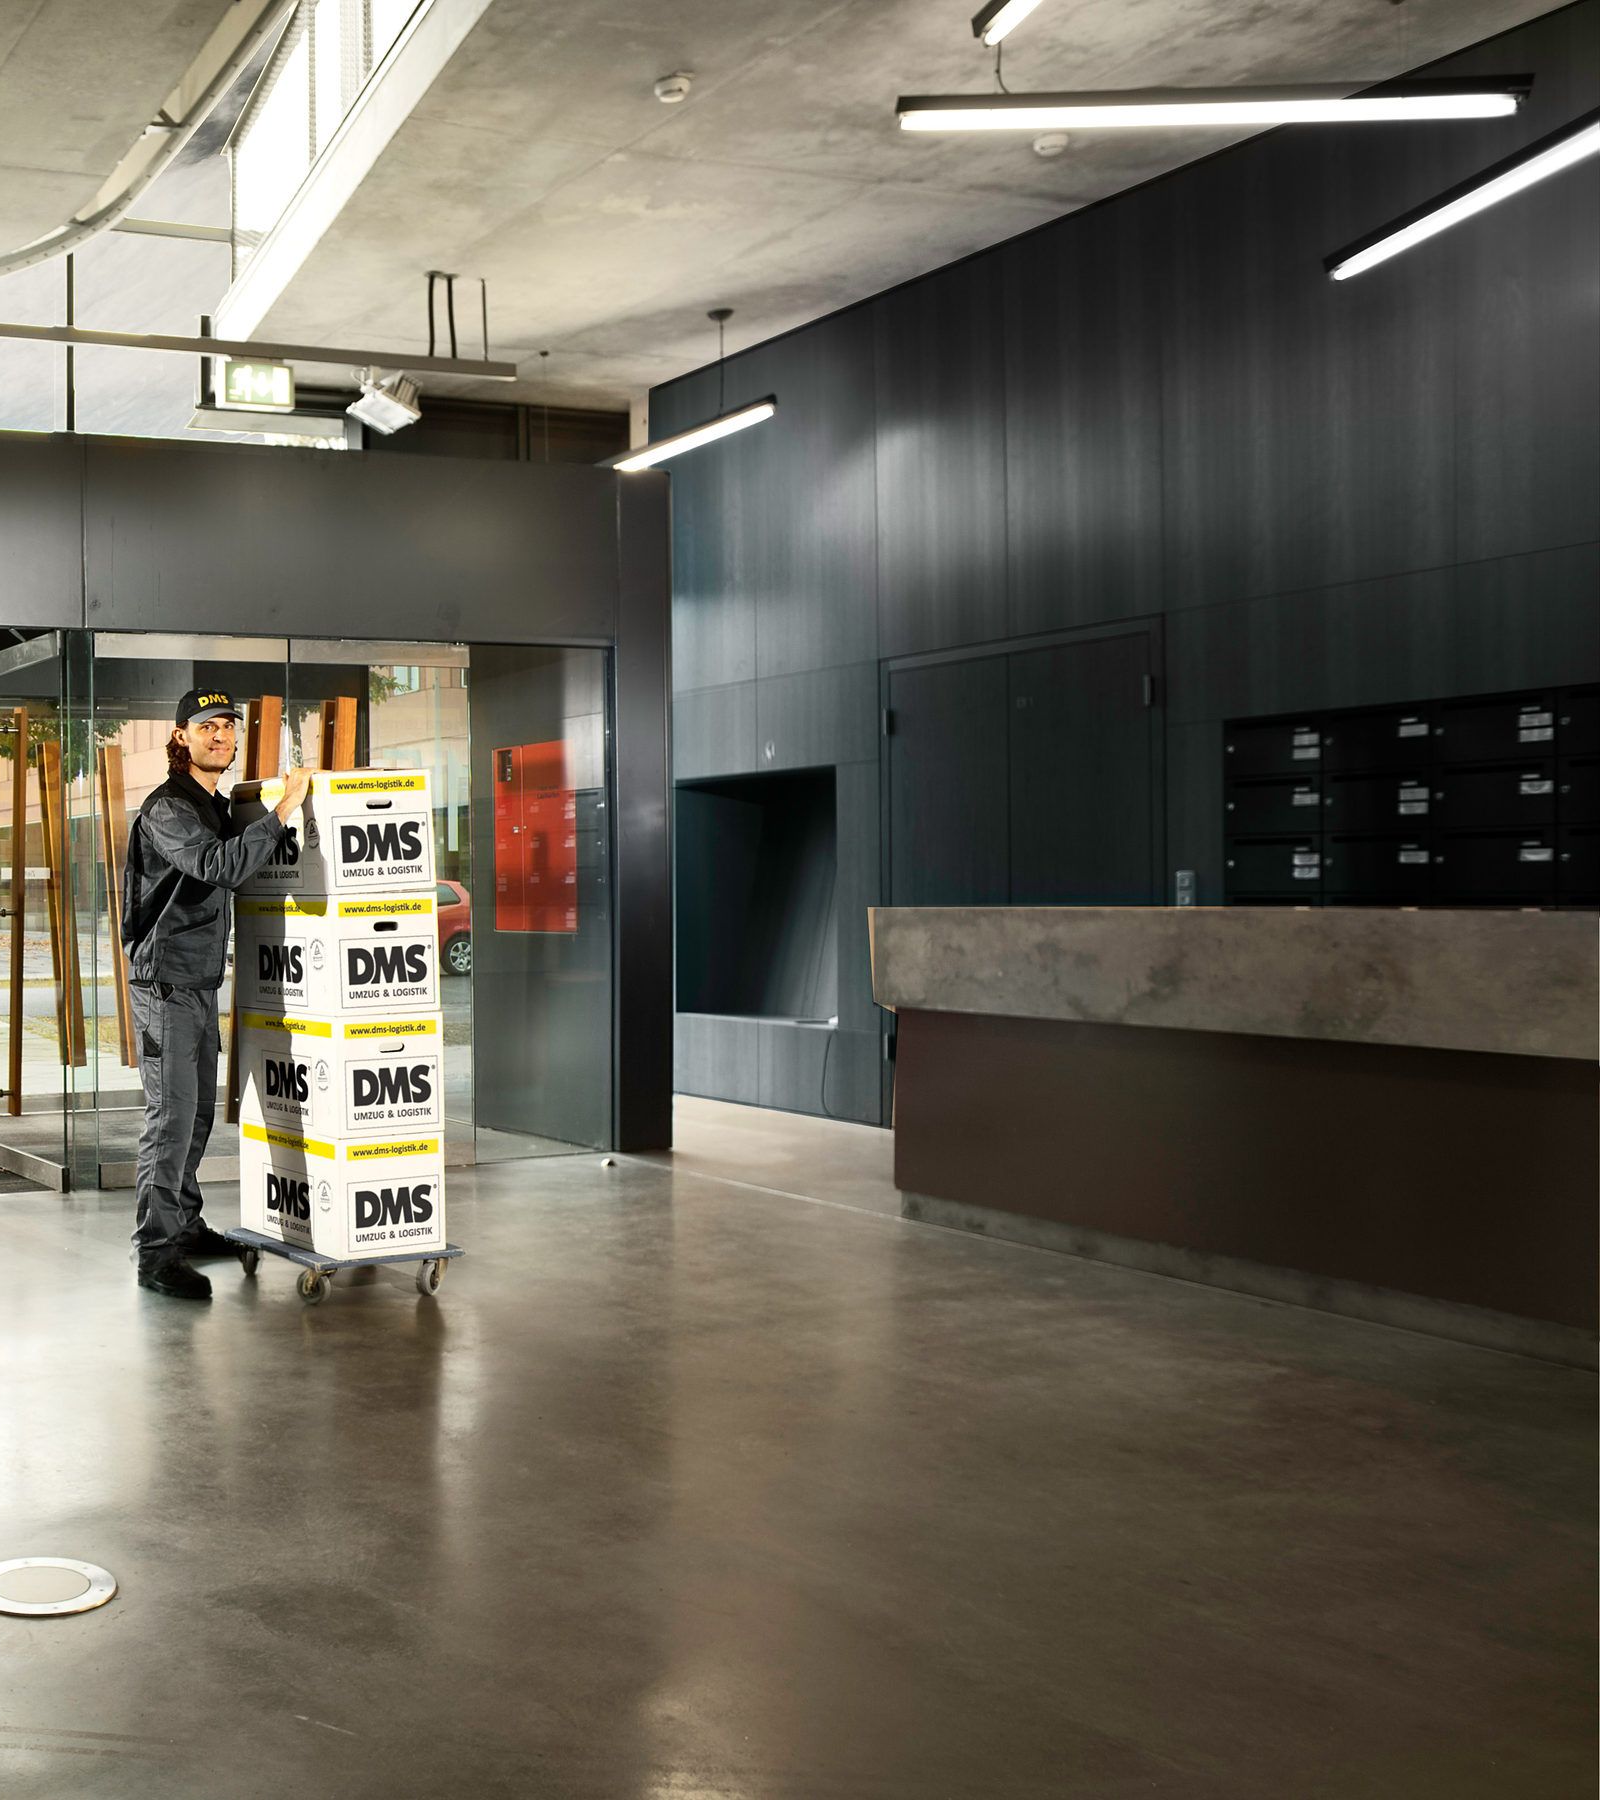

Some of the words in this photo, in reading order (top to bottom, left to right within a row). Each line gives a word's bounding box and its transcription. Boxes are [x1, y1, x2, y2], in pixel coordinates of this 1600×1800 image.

[198, 693, 229, 708] DMS
[337, 779, 414, 790] www.dms-logistik.de
[340, 821, 422, 864] DMS
[343, 868, 374, 878] UMZUG
[378, 867, 385, 876] &
[387, 865, 423, 875] LOGISTIK
[344, 903, 422, 914] www.dms-logistik.de
[259, 944, 303, 984] DMS
[347, 944, 428, 985] DMS
[349, 989, 380, 999] UMZUG
[383, 989, 390, 998] &
[393, 987, 428, 997] LOGISTIK
[350, 1023, 426, 1035] www.dms-logistik.de
[265, 1059, 309, 1102] DMS
[353, 1064, 432, 1107] DMS
[354, 1111, 385, 1121] UMZUG
[387, 1110, 395, 1118] &
[397, 1108, 432, 1117] LOGISTIK
[353, 1144, 428, 1157] www.dms-logistik.de
[266, 1172, 311, 1220] DMS
[355, 1184, 433, 1229] DMS
[356, 1232, 386, 1242] UMZUG
[389, 1231, 396, 1239] &
[399, 1227, 433, 1237] LOGISTIK
